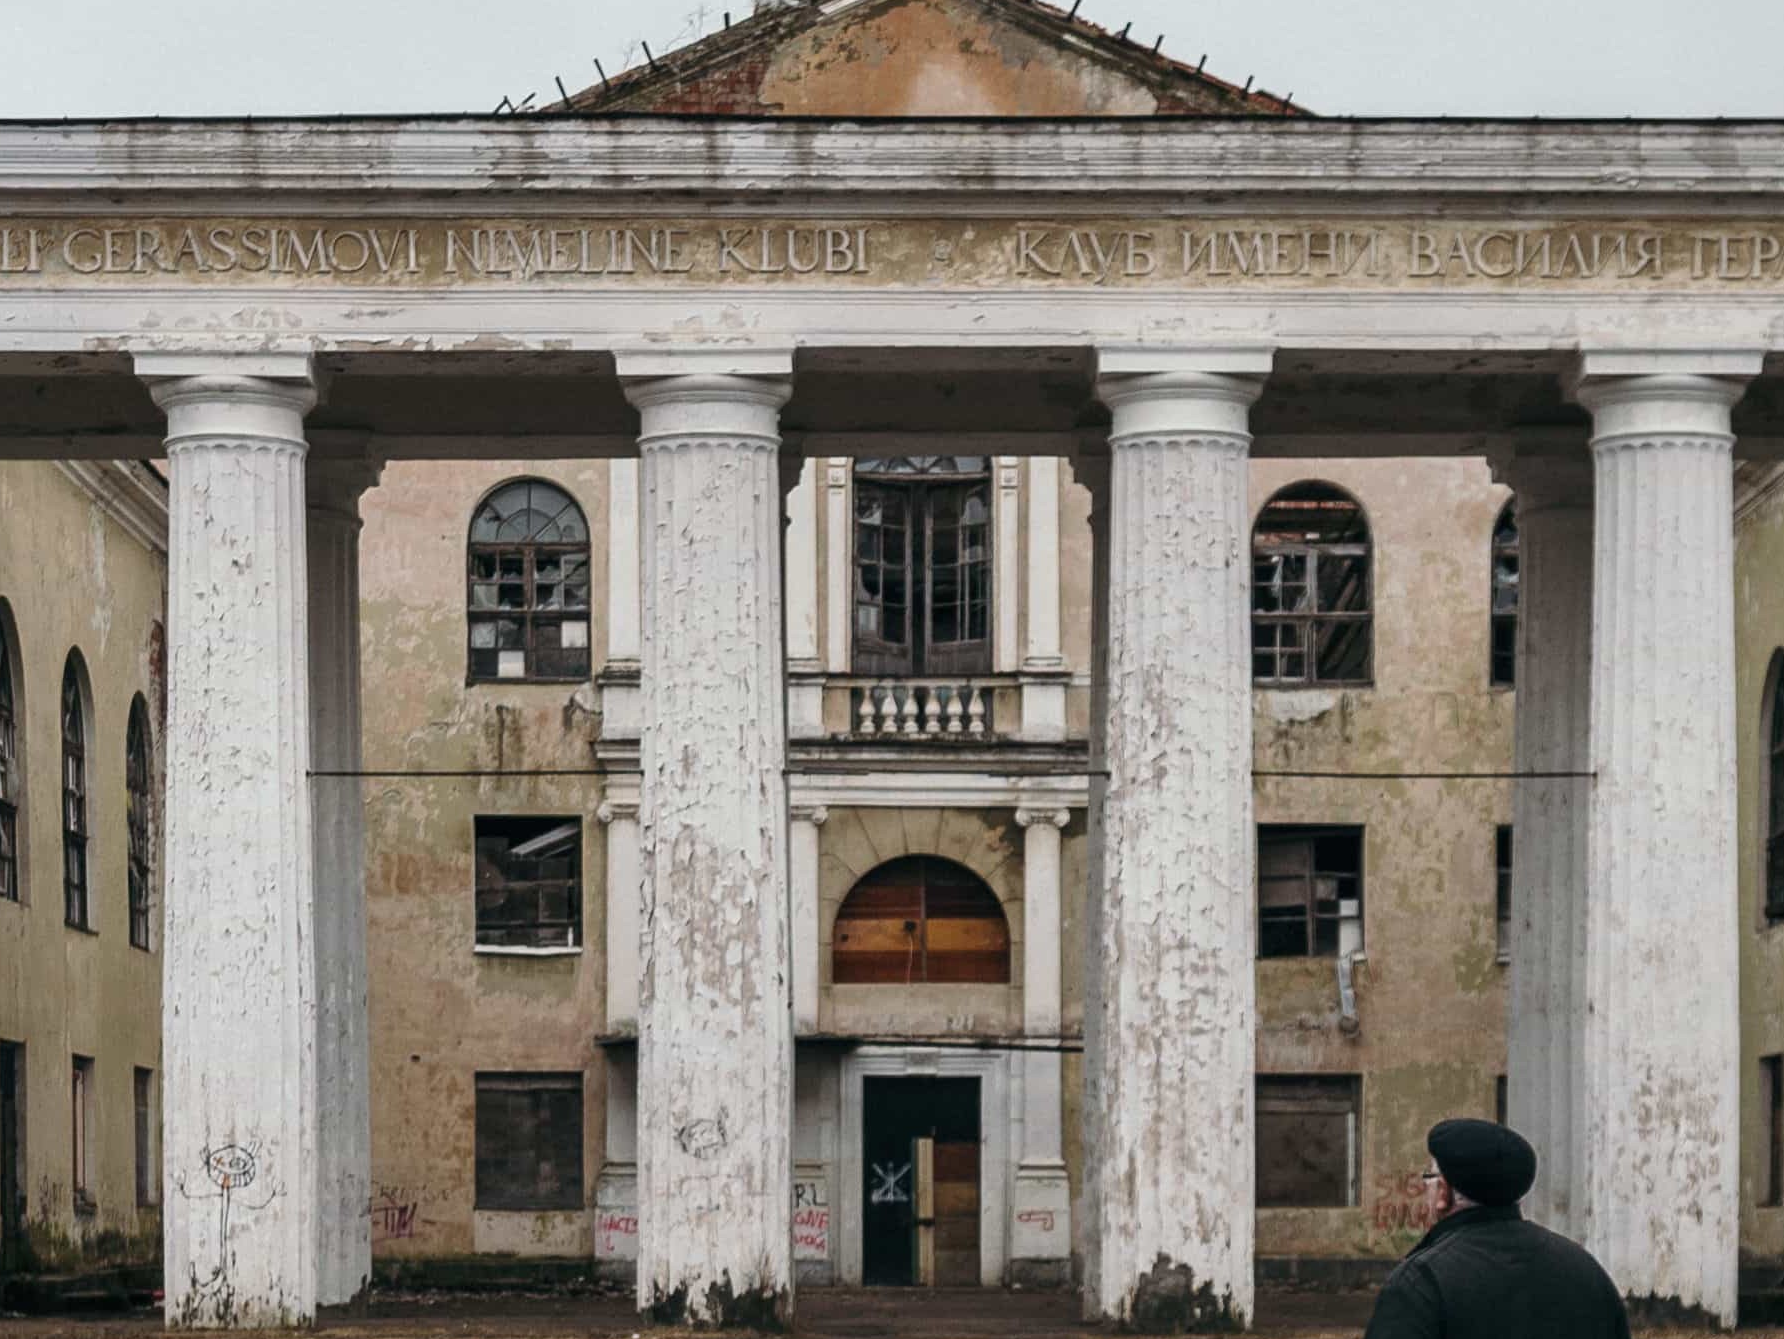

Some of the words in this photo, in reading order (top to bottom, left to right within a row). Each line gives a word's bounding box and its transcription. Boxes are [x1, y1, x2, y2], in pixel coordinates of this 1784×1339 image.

[63, 227, 420, 274] GERASSIMOVI
[444, 228, 696, 275] NIMELINE
[717, 228, 870, 274] KLUBI
[1016, 229, 1157, 283] КЛУБ
[1180, 230, 1380, 277] ИМЕНИ
[1407, 231, 1665, 279] ВАСИЛИЯ
